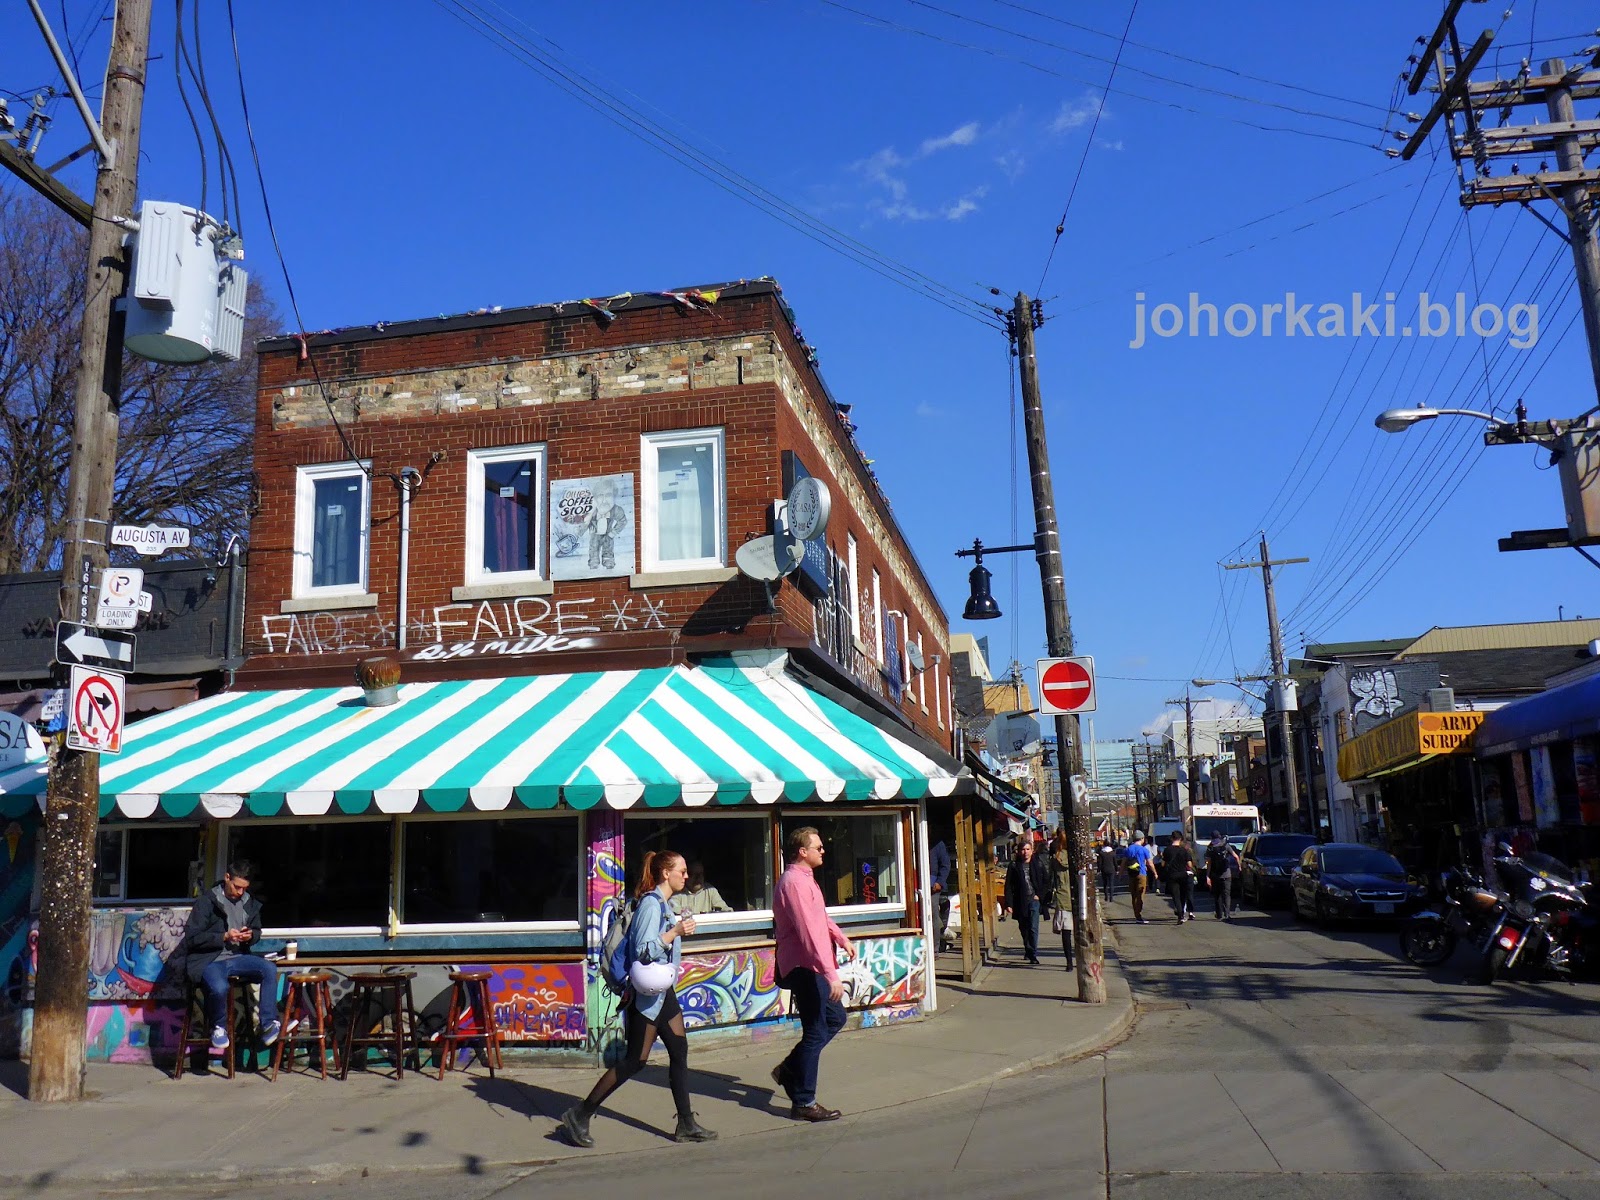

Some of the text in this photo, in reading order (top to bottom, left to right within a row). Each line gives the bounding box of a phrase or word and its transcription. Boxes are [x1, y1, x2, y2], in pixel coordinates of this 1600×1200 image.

[559, 496, 594, 508] COFFEE
[795, 502, 812, 513] CASA
[561, 505, 593, 516] STOP
[116, 529, 166, 543] AUGUSTA
[432, 597, 600, 642] FAIRE
[262, 612, 370, 656] FAIRE
[1440, 716, 1481, 731] ARMY
